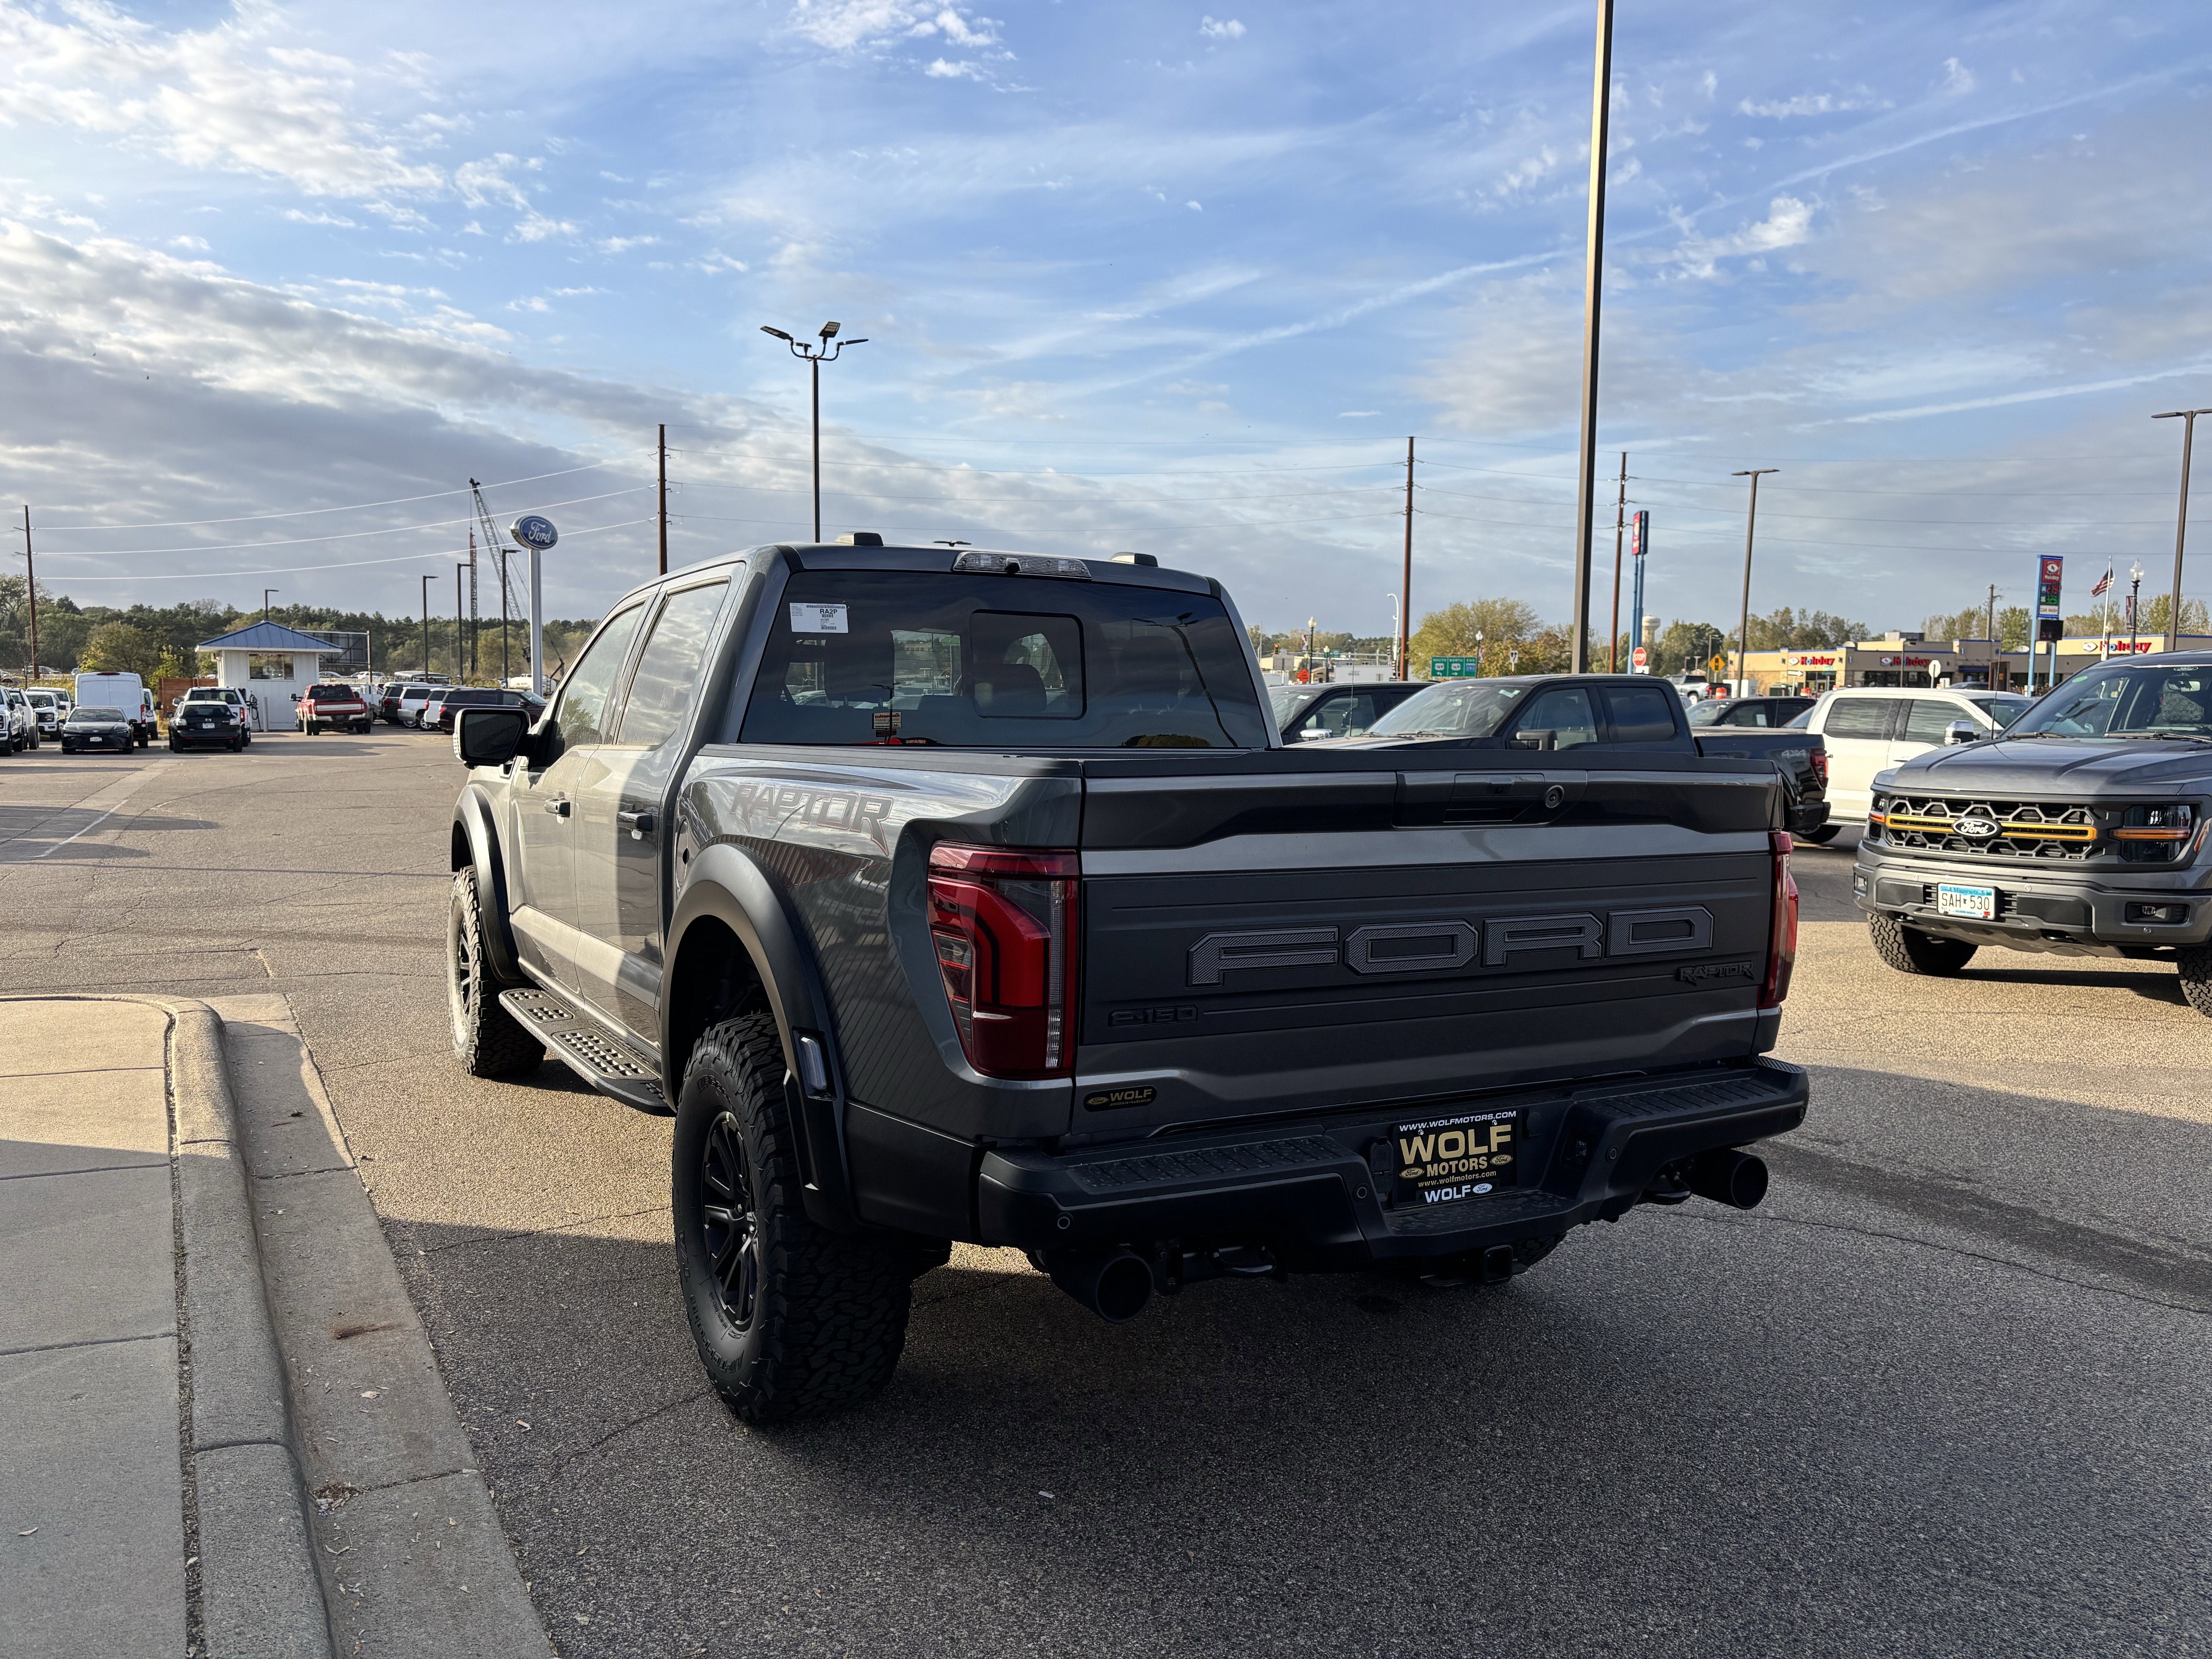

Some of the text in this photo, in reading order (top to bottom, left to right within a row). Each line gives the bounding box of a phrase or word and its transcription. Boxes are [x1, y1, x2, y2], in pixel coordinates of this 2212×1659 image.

[528, 521, 551, 543] Ford
[1801, 656, 1835, 666] Holiday
[730, 782, 894, 857] RAPTOR
[1961, 821, 1989, 834] Ford
[1942, 893, 1989, 910] SAH 530
[1186, 904, 1714, 988] FORD
[1674, 960, 1755, 986] RAPTOR
[1108, 1005, 1199, 1029] F-150
[1110, 1089, 1152, 1102] WOLF
[1399, 1111, 1516, 1132] WWW.WOLFMOTORS.COM
[1400, 1124, 1511, 1165] WOLF
[1426, 1156, 1488, 1177] MOTORS
[1418, 1171, 1496, 1187] www.wolfmotors.com
[1424, 1185, 1471, 1203] WOLF
